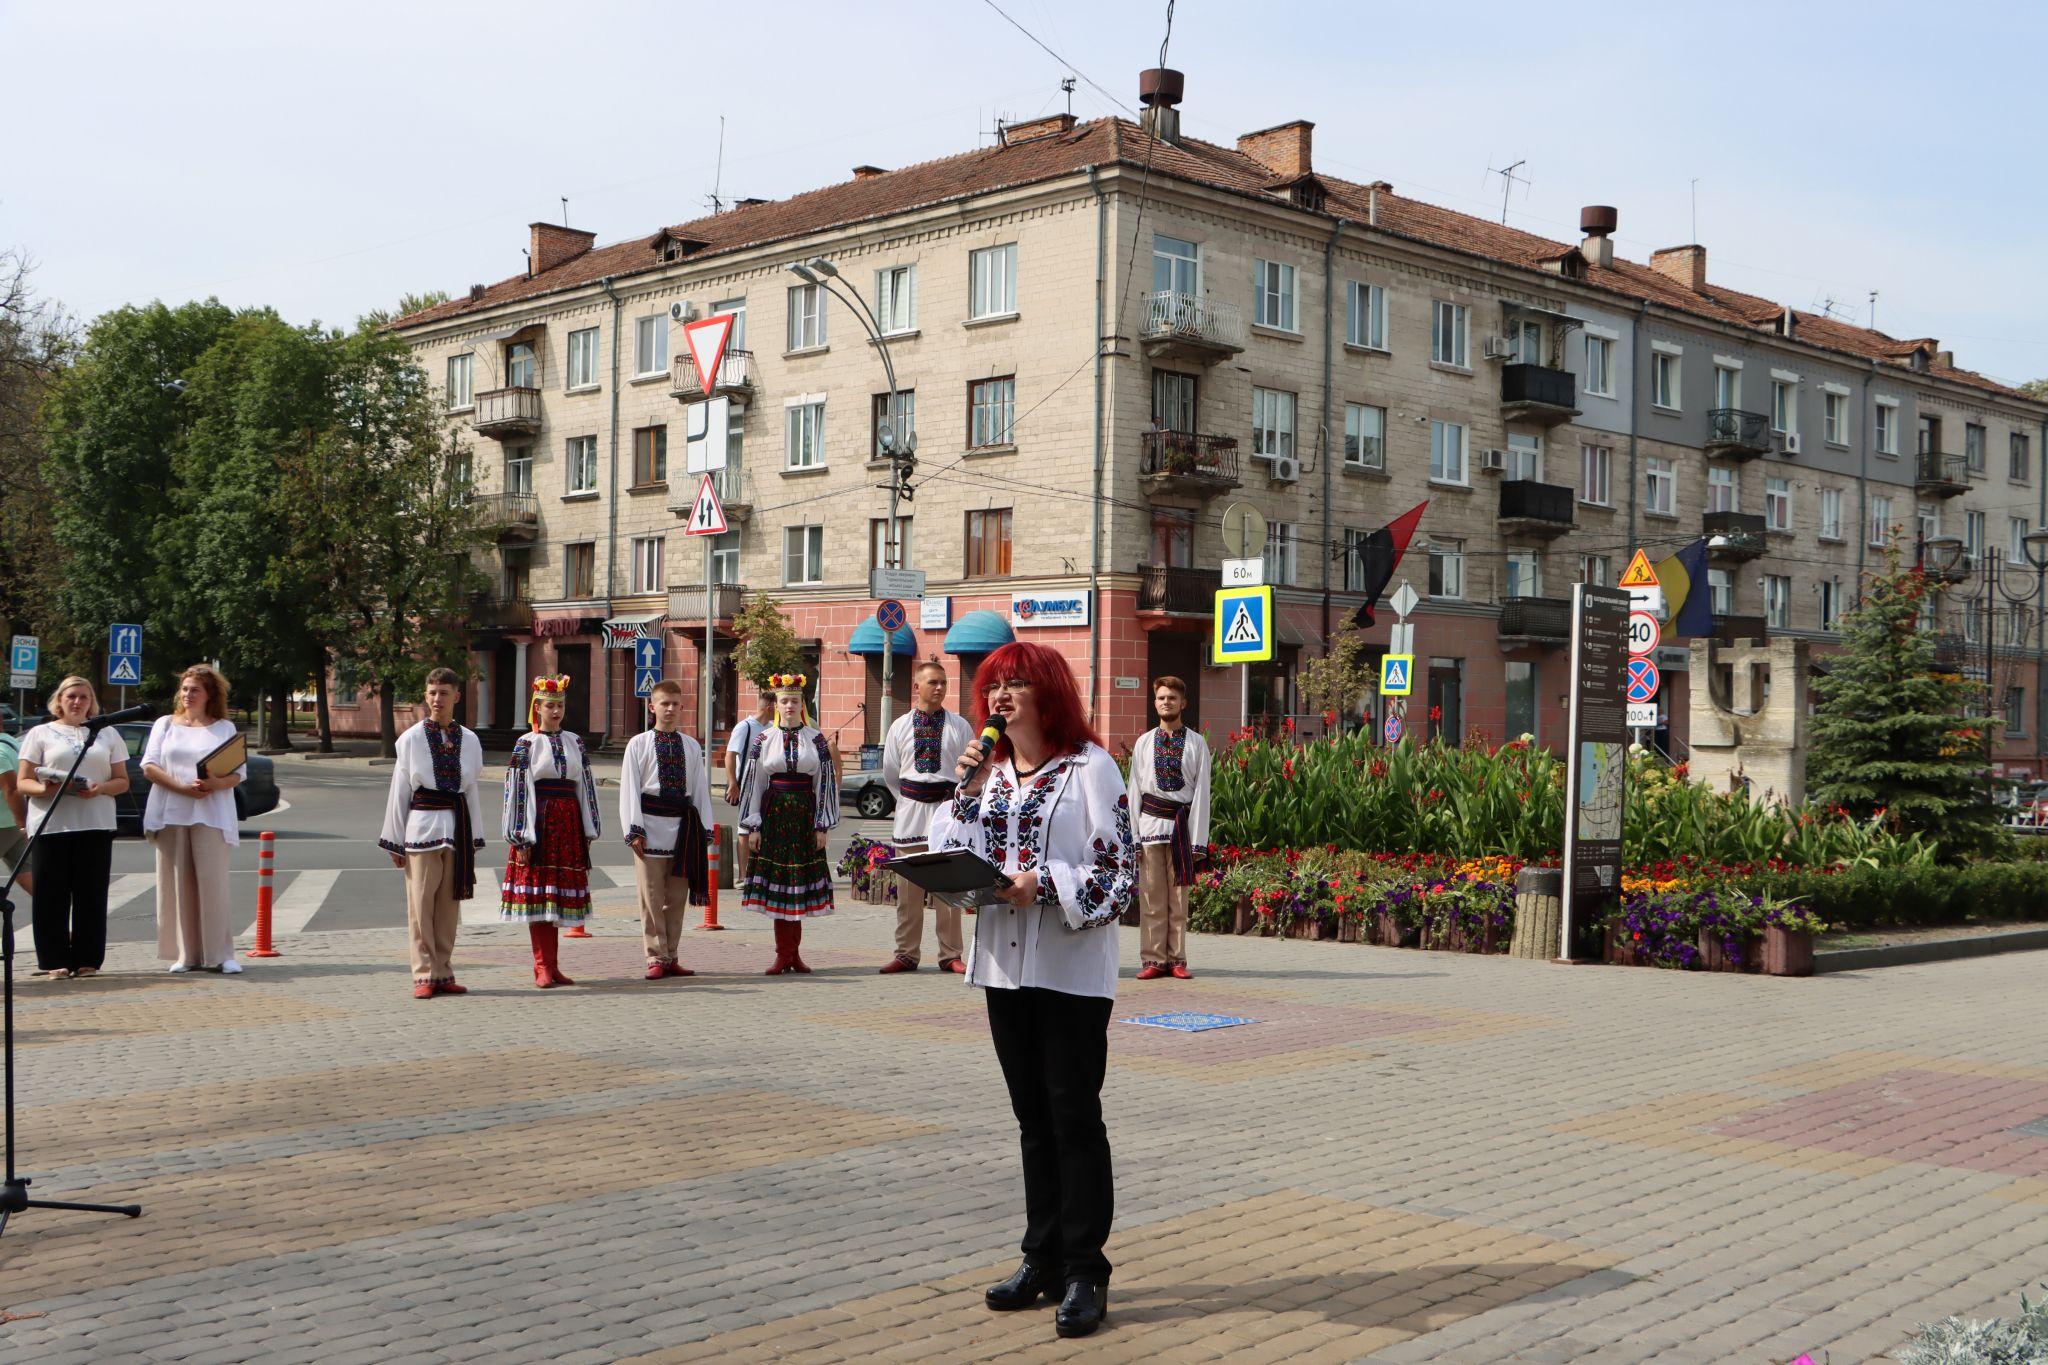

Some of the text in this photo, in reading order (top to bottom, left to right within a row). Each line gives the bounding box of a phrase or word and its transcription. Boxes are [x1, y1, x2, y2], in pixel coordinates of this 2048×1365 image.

[1234, 568, 1252, 578] 60м
[1629, 623, 1650, 642] 40
[15, 638, 36, 646] ЗОНА
